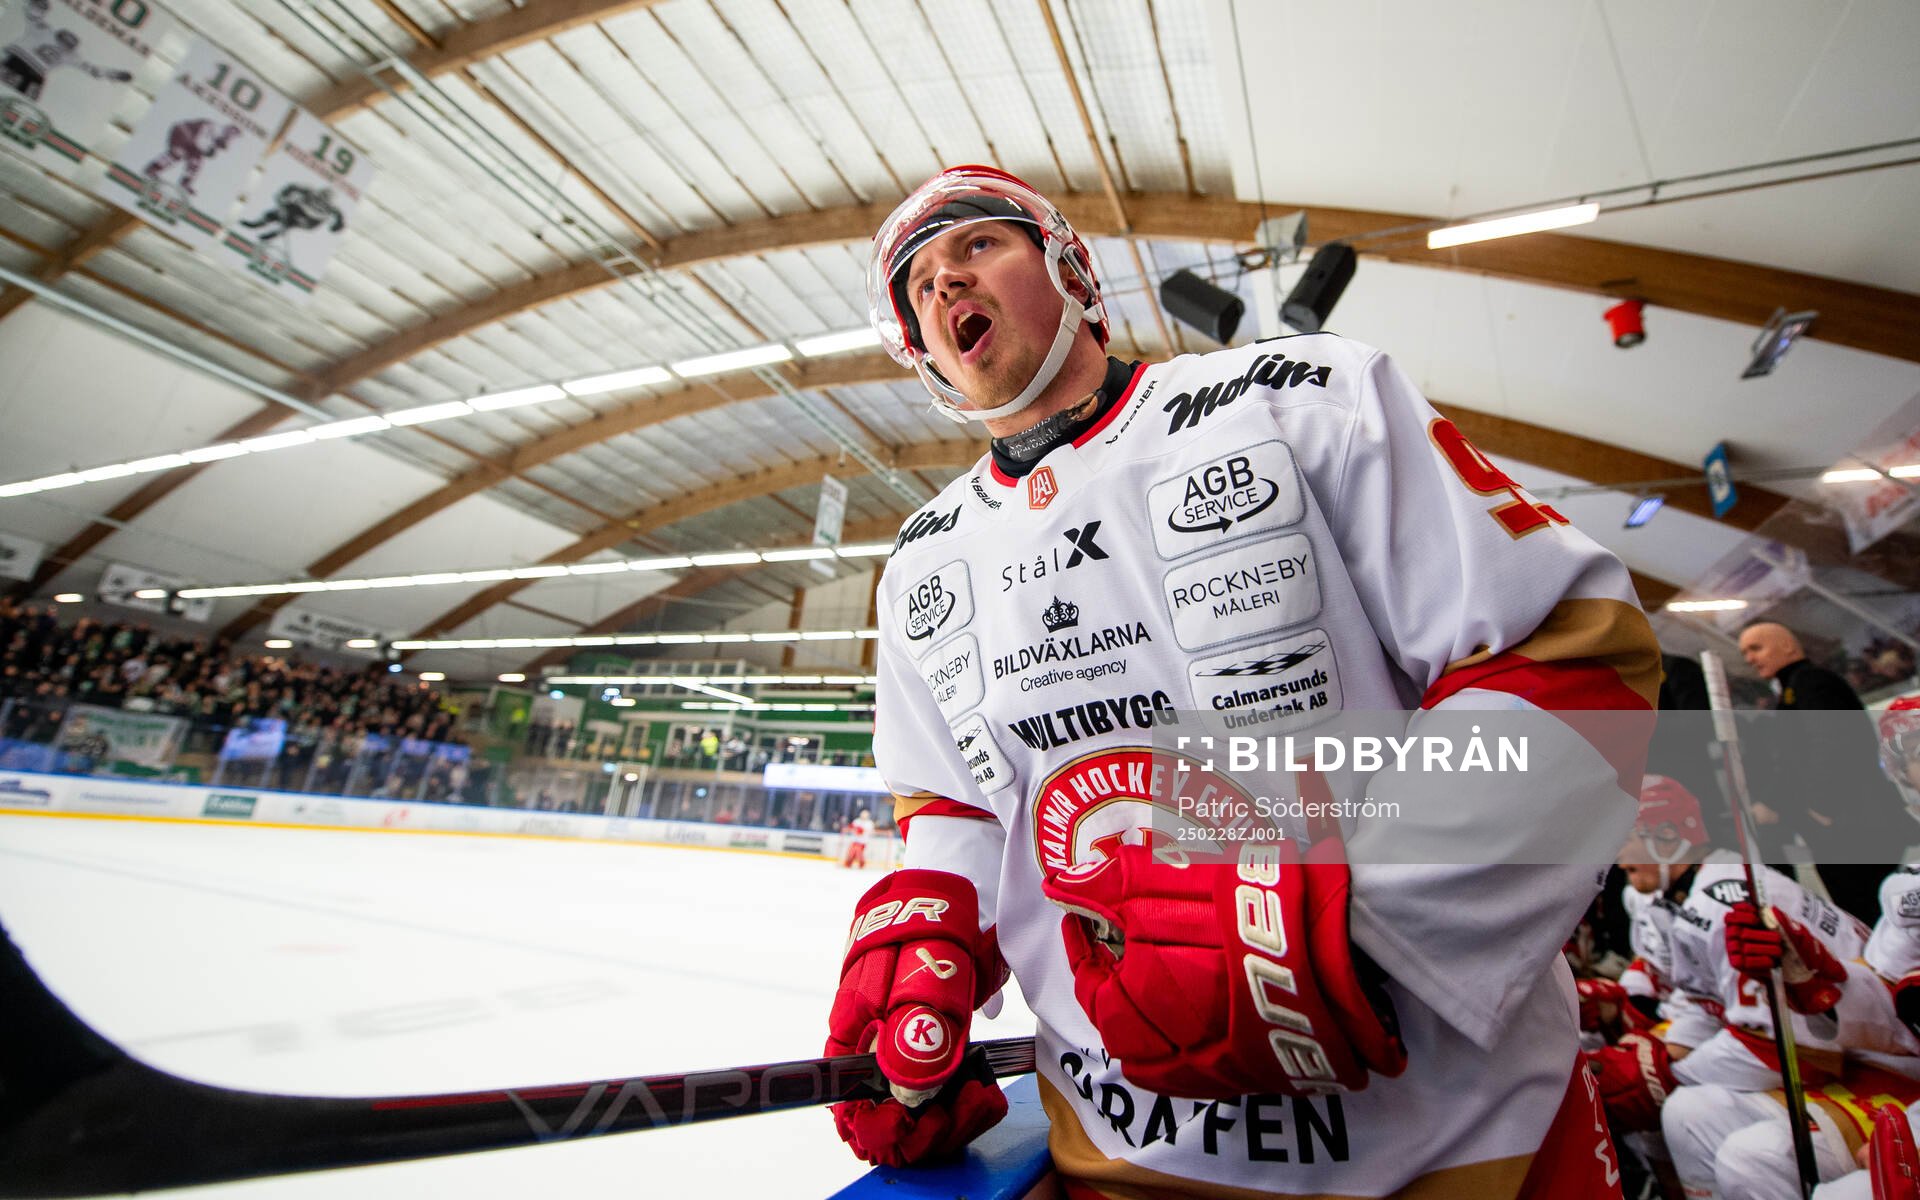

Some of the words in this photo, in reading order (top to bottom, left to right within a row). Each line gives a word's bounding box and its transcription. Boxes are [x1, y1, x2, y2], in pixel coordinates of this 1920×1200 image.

[207, 64, 262, 111] 10
[313, 135, 355, 175] 19
[1163, 354, 1332, 436] Molins
[1183, 456, 1254, 507] AGB
[1184, 488, 1260, 524] SERVICE
[889, 503, 963, 558] lins
[908, 575, 943, 619] AGB
[1173, 554, 1308, 608] ROCKNEBY
[911, 600, 947, 633] SERVICE
[1213, 590, 1280, 619] MÅLERI
[928, 651, 972, 691] CKNEBY
[994, 621, 1153, 680] BILDVÄXLARNA
[1020, 669, 1074, 692] Creative
[1076, 659, 1127, 681] agency
[1212, 668, 1328, 710] Calmarsunds
[1223, 699, 1304, 729] Undertak
[1309, 691, 1328, 710] AB
[1069, 762, 1190, 804] HOCKEY
[911, 1018, 938, 1047] K
[505, 1055, 885, 1143] VAPOR
